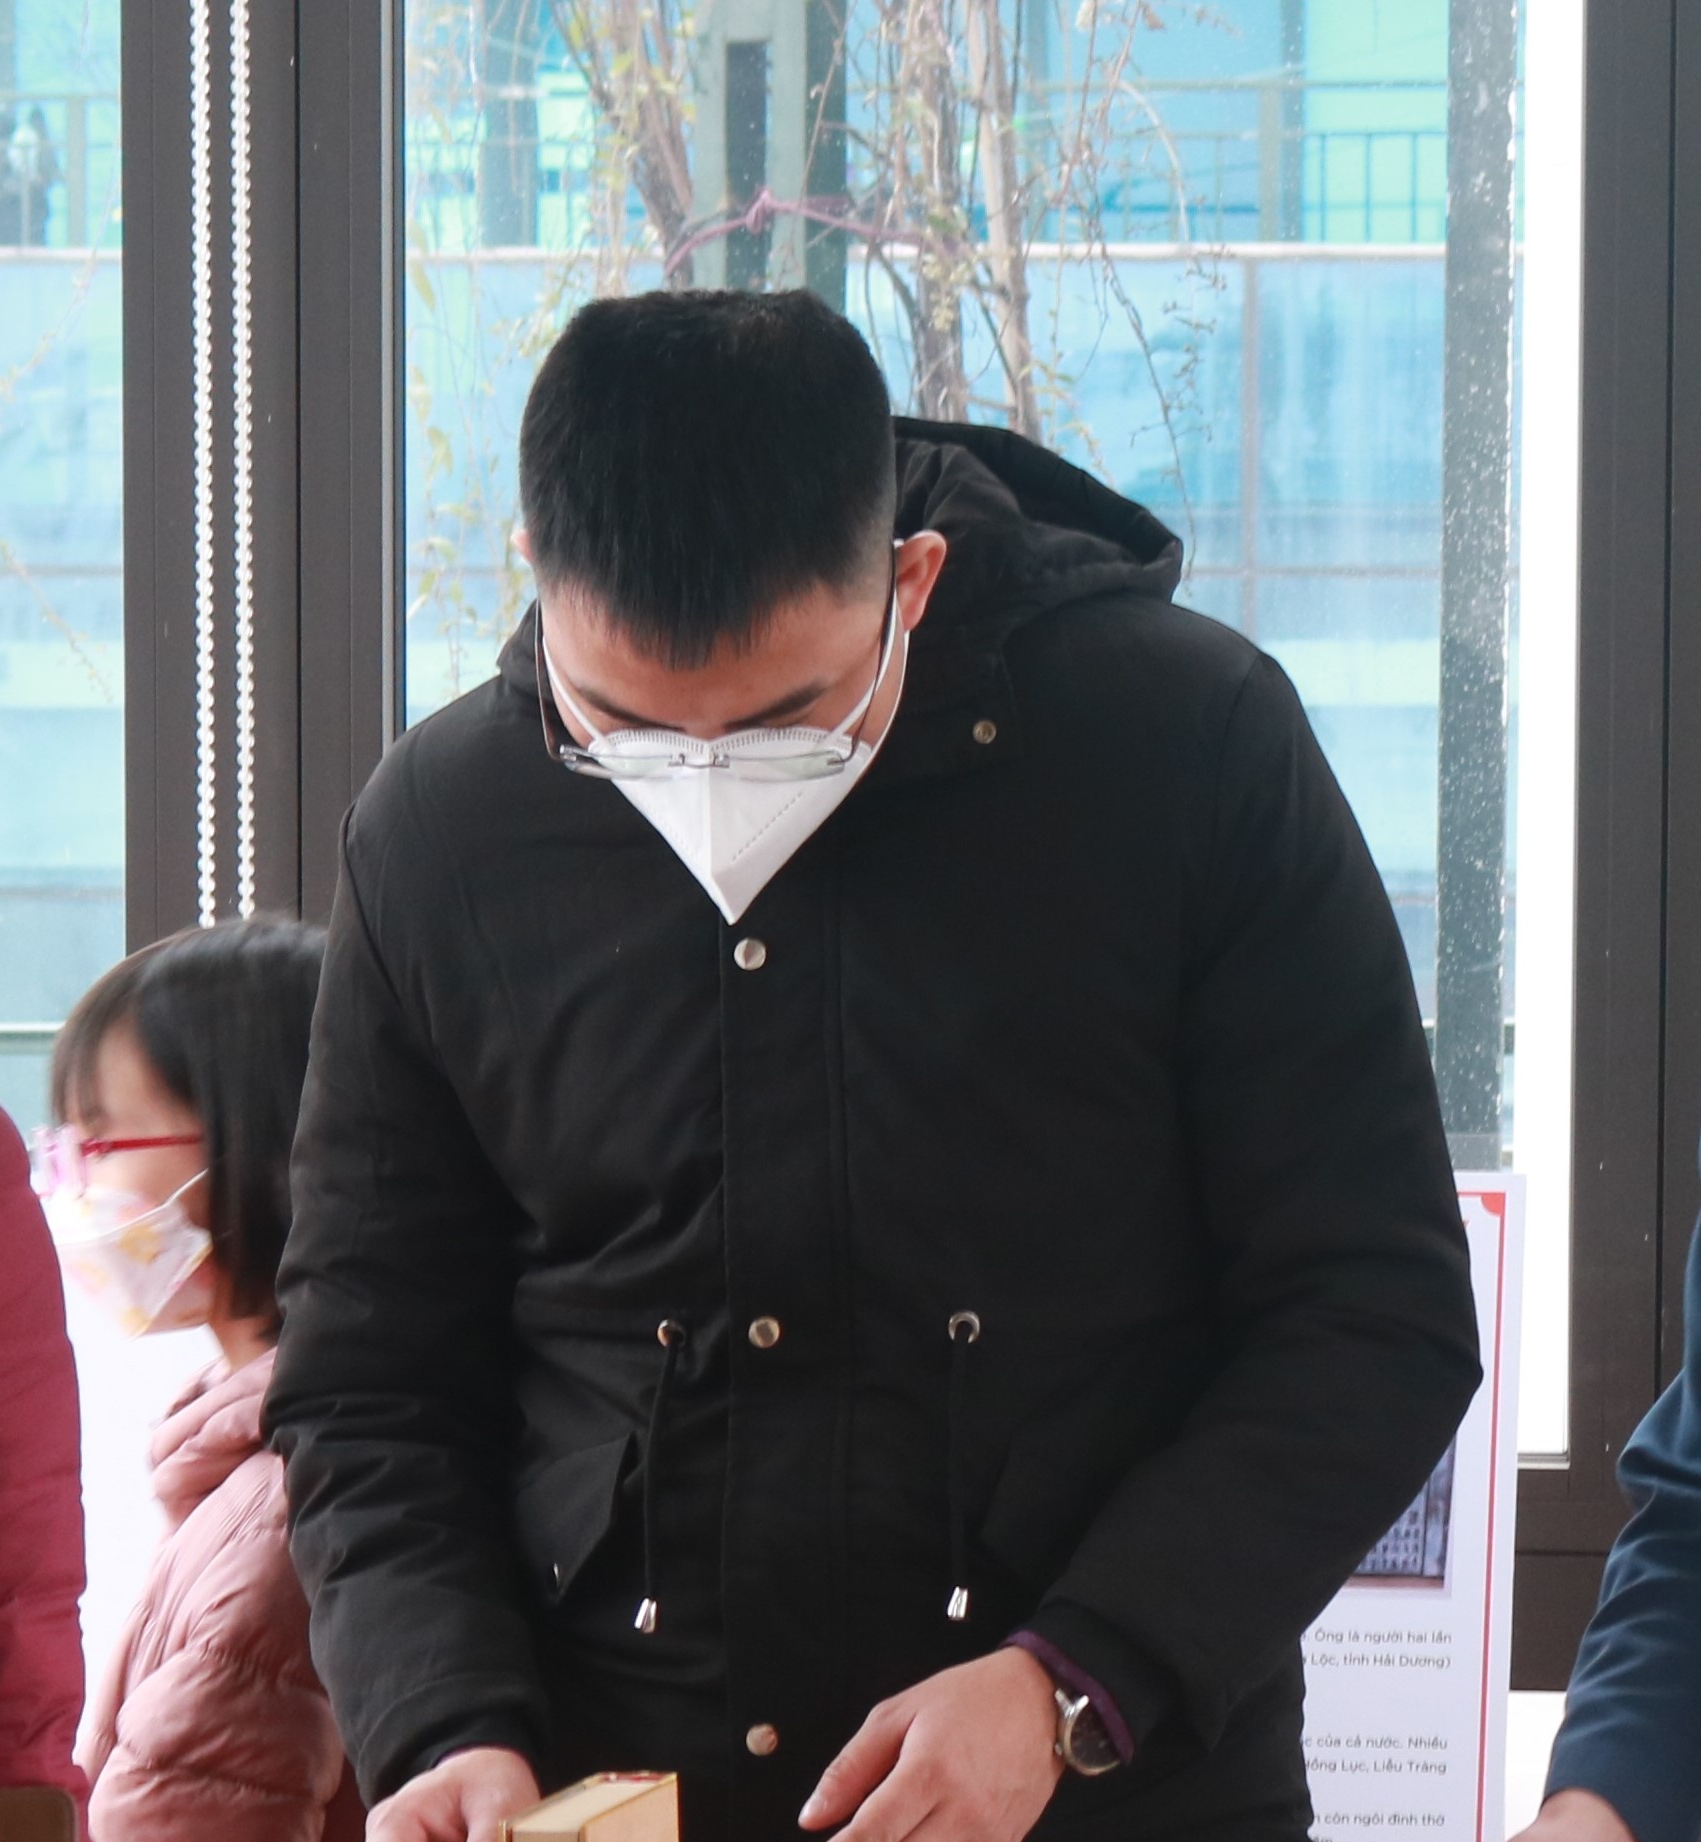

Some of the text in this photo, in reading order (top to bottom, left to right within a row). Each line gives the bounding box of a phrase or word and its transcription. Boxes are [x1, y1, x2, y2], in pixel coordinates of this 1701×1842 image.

[1314, 1628, 1344, 1644] Ông
[1348, 1630, 1360, 1643] là
[1364, 1630, 1402, 1645] người
[1407, 1631, 1427, 1643] hai
[1311, 1654, 1339, 1668] Lộc,
[1373, 1653, 1395, 1667] Hải
[1399, 1654, 1451, 1669] Dương)
[1316, 1734, 1341, 1748] của
[1345, 1734, 1361, 1748] cả
[1407, 1735, 1448, 1750] Nhiều
[1324, 1812, 1445, 1827] còn ngôi đình thờ
